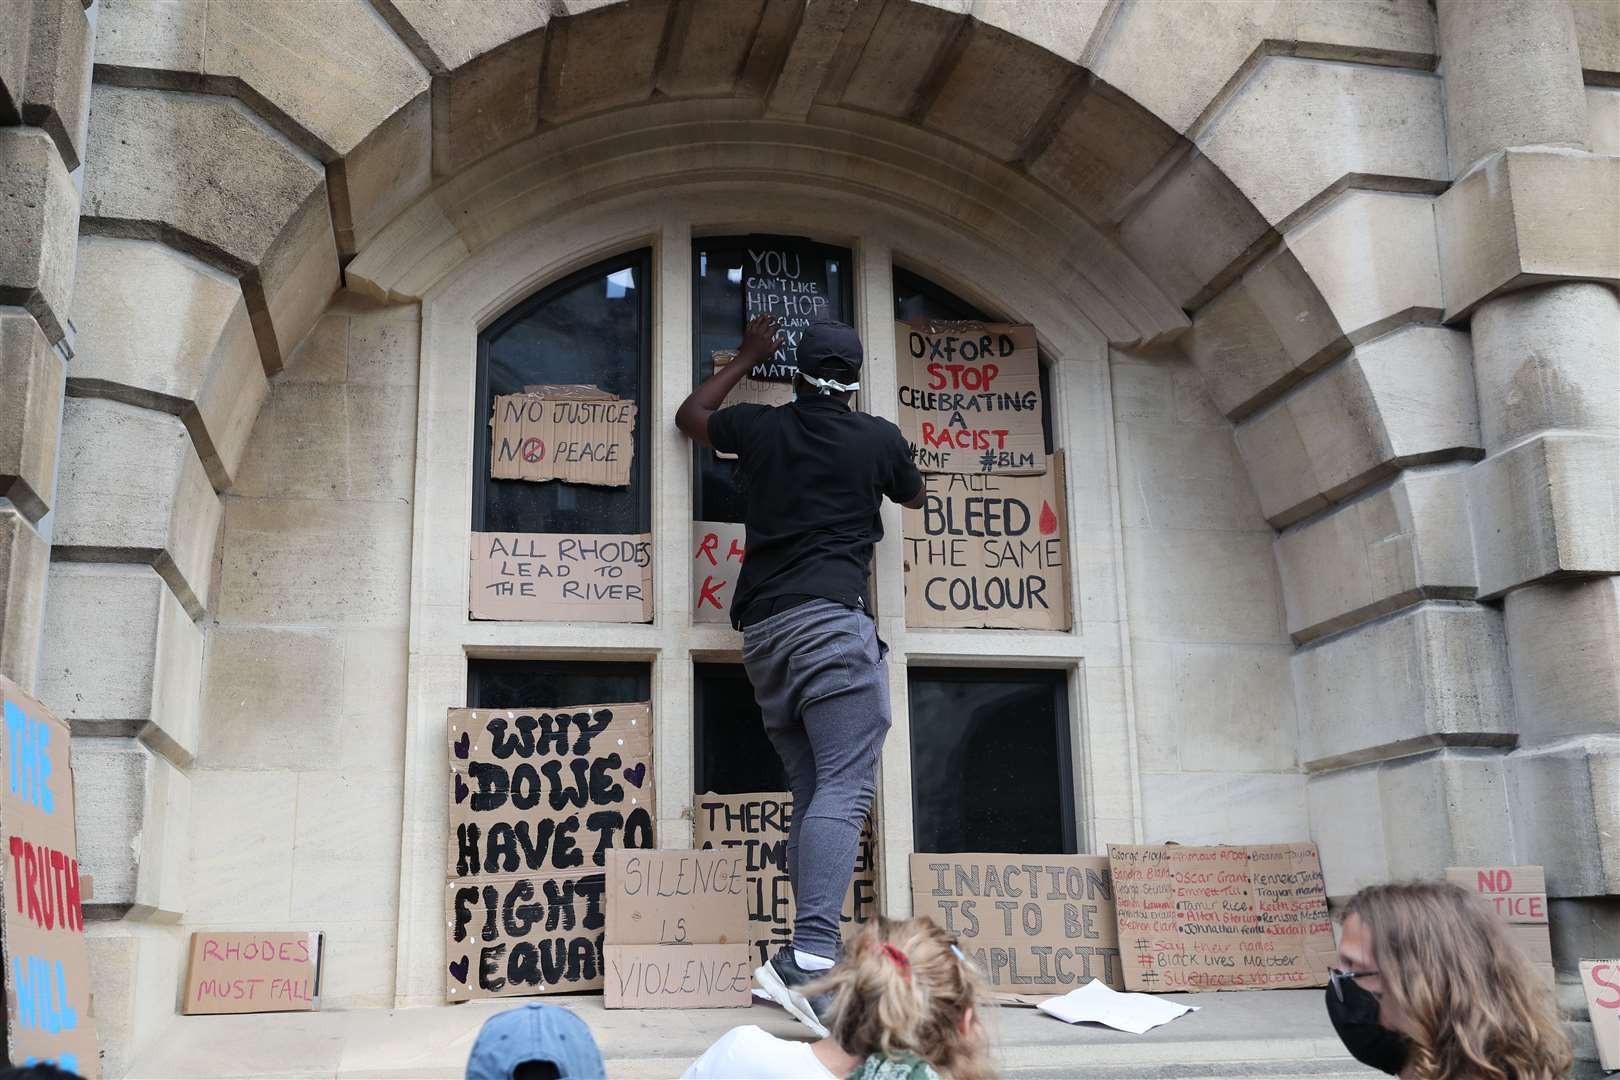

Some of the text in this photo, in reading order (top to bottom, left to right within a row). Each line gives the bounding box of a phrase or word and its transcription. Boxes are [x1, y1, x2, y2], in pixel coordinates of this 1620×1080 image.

[748, 249, 800, 278] YOU
[747, 277, 818, 294] CAN'T LIKE
[747, 292, 825, 316] HIP HOP
[777, 316, 810, 327] CLAIM
[774, 348, 798, 361] N'T
[909, 332, 1015, 361] OXFORD
[752, 364, 799, 378] MATT
[927, 362, 999, 392] STOP
[898, 385, 1037, 412] CELEBRATING
[503, 400, 630, 424] NO JUSTICE
[948, 411, 968, 429] A
[921, 422, 1009, 449] RACIST
[553, 441, 619, 463] PEACE
[979, 448, 1034, 472] #BLM
[924, 473, 938, 492] E
[923, 495, 1031, 537] BLEED
[489, 538, 652, 568] ALL RHODES
[903, 537, 1064, 569] THE SAME
[501, 561, 623, 578] LEAD TO
[486, 581, 644, 600] THE RIVER
[925, 575, 1049, 611] COLOUR
[486, 709, 613, 759] WHY
[4, 698, 55, 816] THE
[456, 807, 654, 877] HAVE TO
[9, 836, 84, 932] TRUTH
[624, 857, 743, 896] SILENCE
[928, 863, 1111, 901] INACTION
[1175, 871, 1214, 884] Oscar
[1217, 870, 1248, 883] Grant
[1477, 870, 1512, 892] NO
[454, 873, 605, 943] FIGHT
[1186, 911, 1220, 922] Alton
[1222, 900, 1248, 911] Rice
[1493, 897, 1544, 917] TICE
[660, 918, 686, 943] IS
[937, 900, 1100, 939] IS TO BE
[203, 939, 310, 963] RHODES
[1243, 954, 1299, 967] Matter
[197, 978, 312, 1002] MUST FALL
[611, 960, 747, 997] VIOLENCE
[13, 954, 77, 1034] WILL
